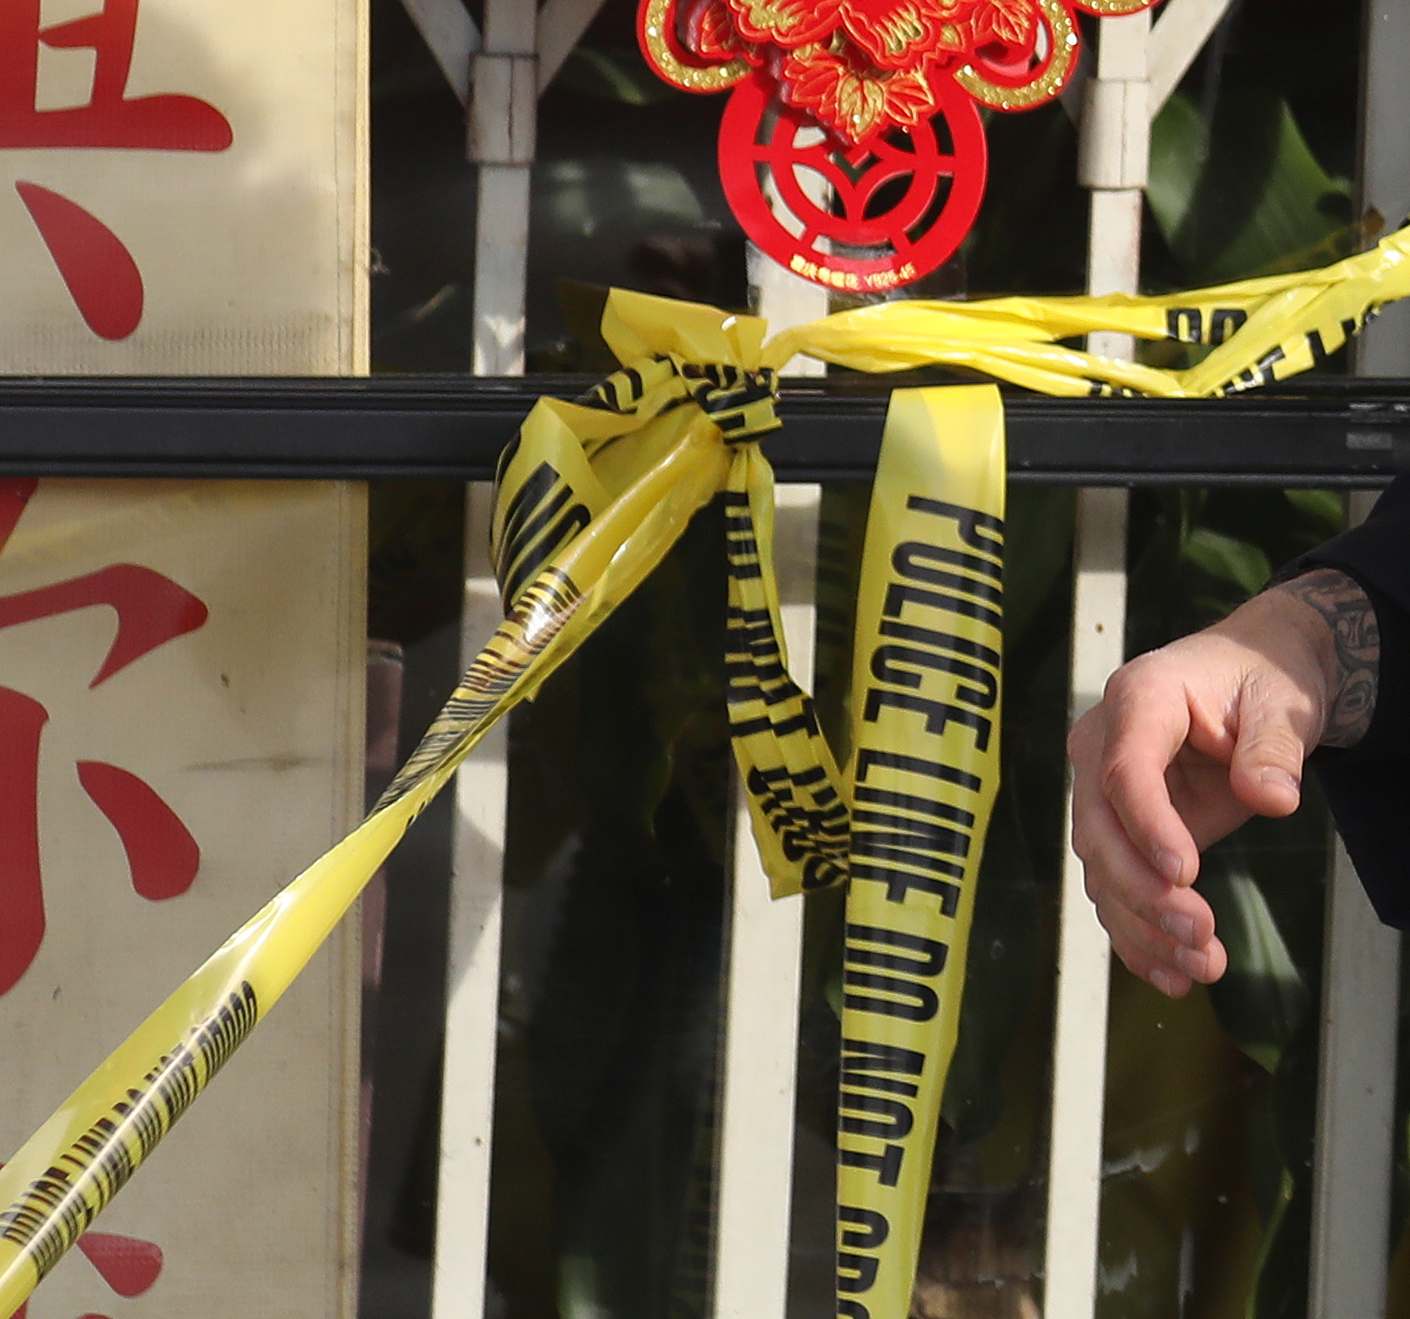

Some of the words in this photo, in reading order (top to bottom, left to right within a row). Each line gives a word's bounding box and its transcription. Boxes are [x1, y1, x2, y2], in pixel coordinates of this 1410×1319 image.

[863, 494, 1005, 756] POLICE
[849, 769, 982, 920] LINE
[845, 923, 949, 1025] DO
[838, 1039, 925, 1189] NOT
